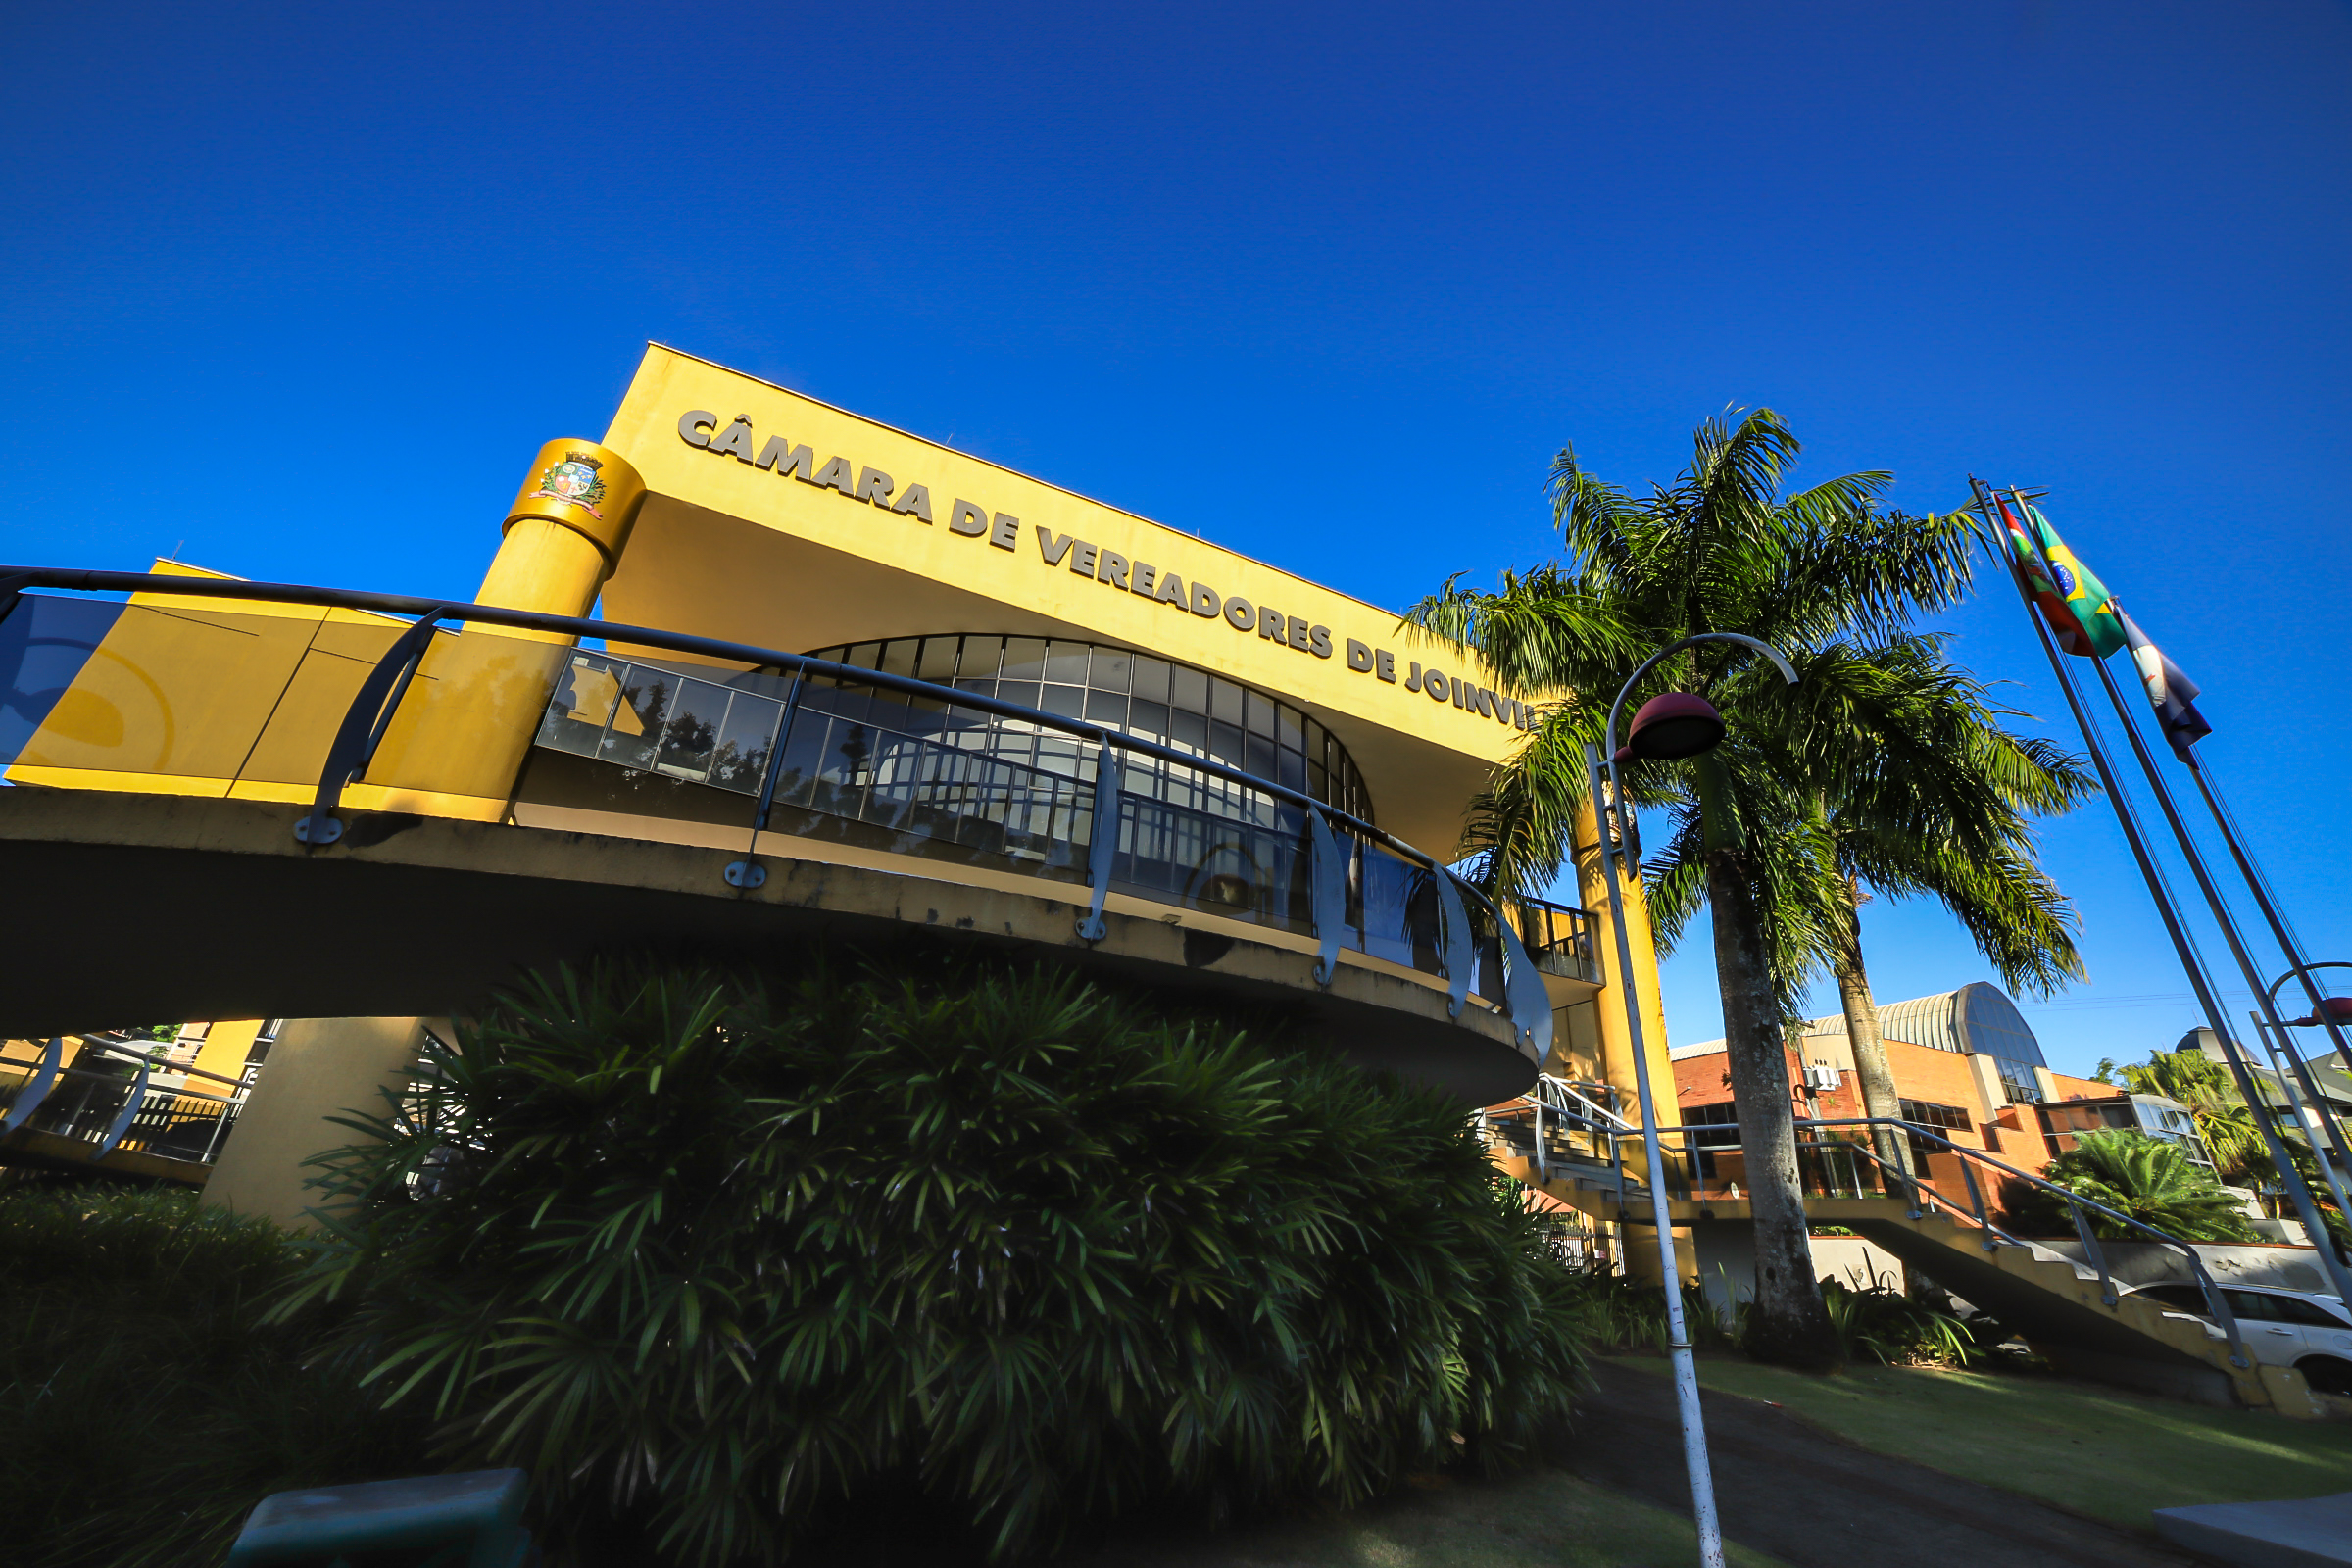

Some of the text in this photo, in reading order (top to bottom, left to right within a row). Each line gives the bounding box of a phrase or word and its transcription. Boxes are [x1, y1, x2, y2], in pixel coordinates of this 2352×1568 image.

[678, 410, 933, 525] CÂMARA
[949, 498, 1020, 552] DE
[1036, 525, 1333, 659] VEREADORES
[1347, 638, 1396, 684] DE
